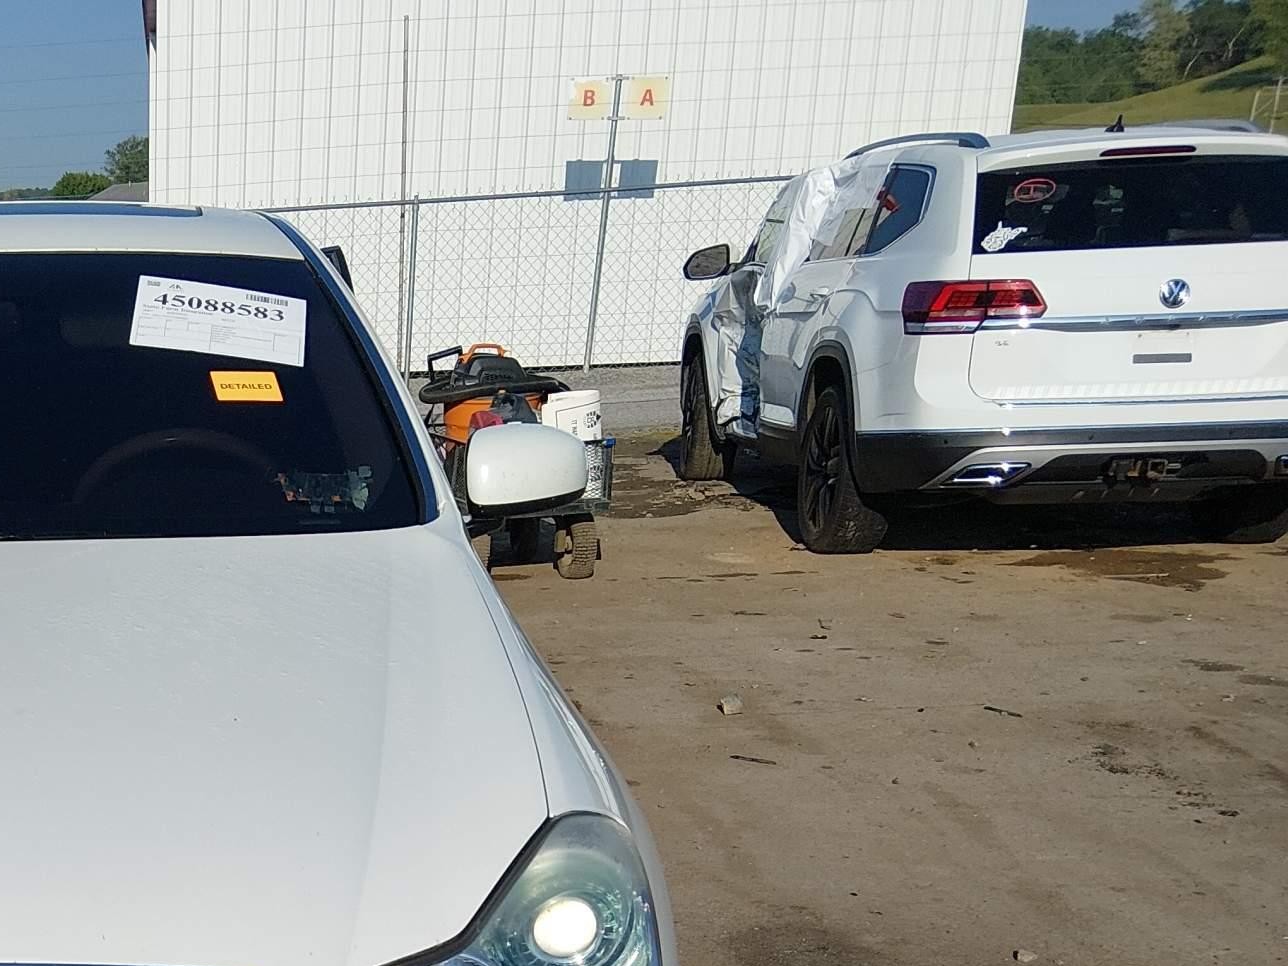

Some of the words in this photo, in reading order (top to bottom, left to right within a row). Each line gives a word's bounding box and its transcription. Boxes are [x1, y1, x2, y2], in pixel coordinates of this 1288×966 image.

[583, 89, 595, 107] B
[640, 88, 654, 106] A
[153, 292, 286, 322] 45088583
